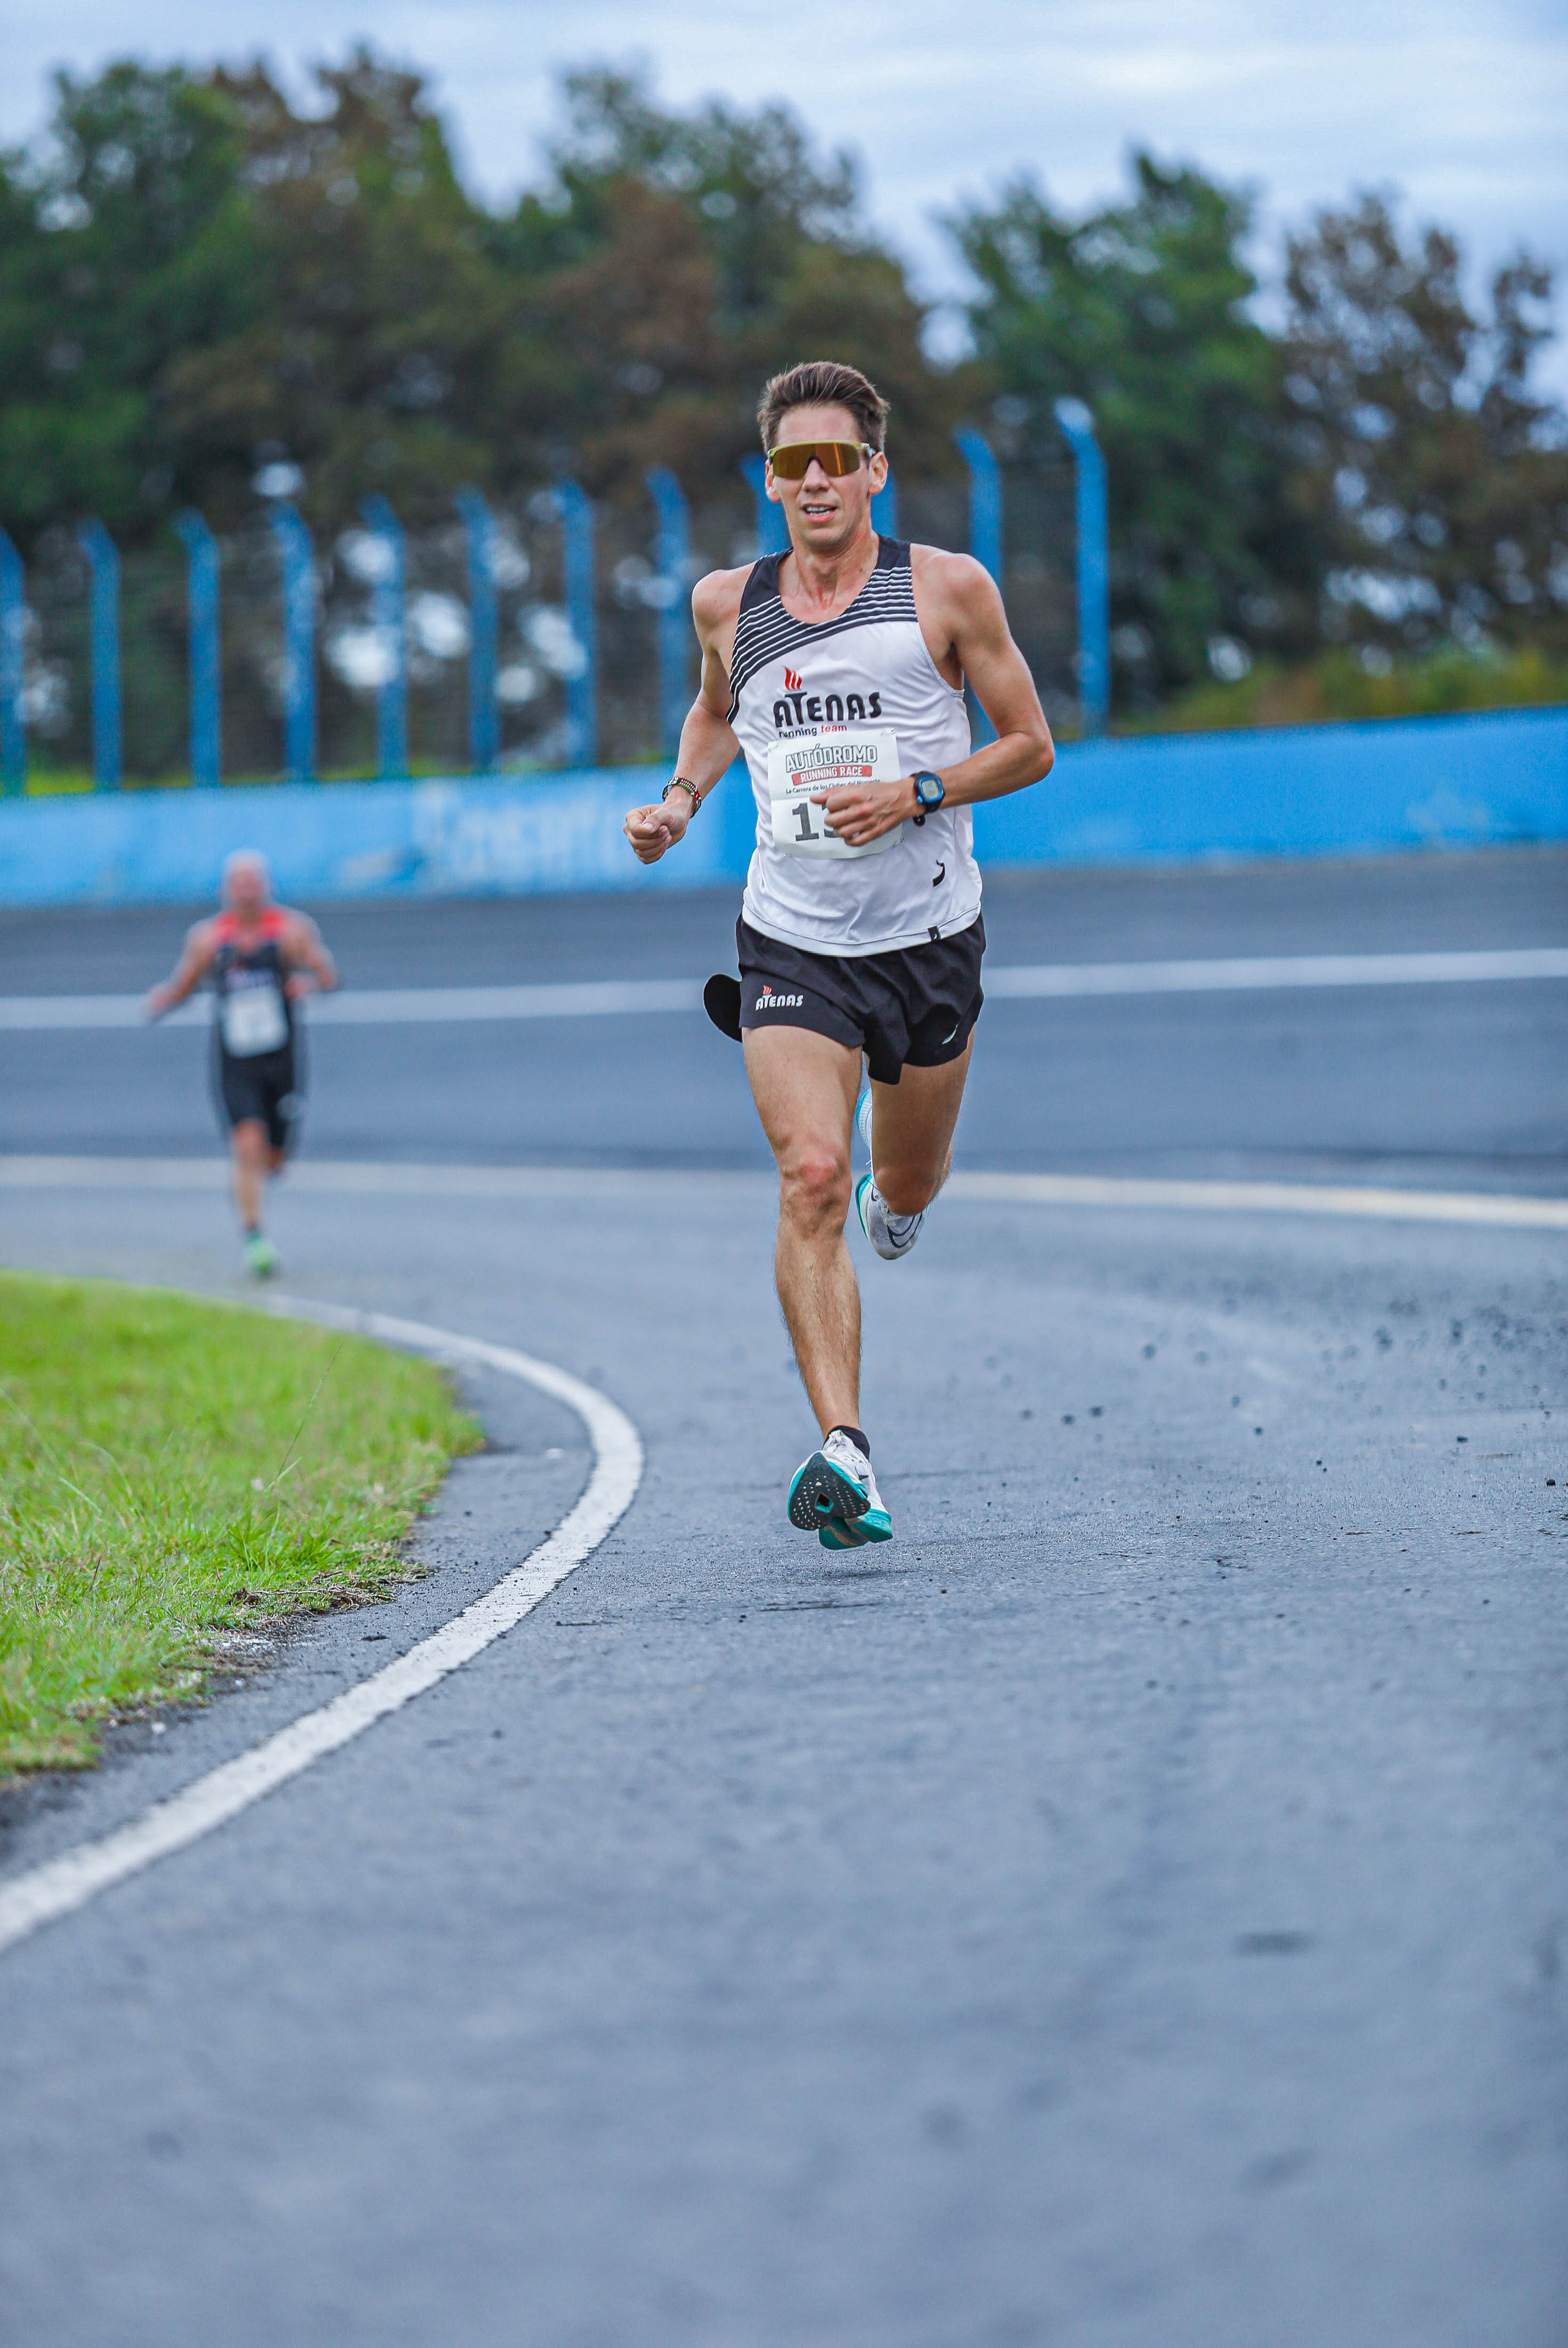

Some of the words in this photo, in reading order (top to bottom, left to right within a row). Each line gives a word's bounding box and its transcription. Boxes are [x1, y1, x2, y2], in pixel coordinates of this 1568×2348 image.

[779, 727, 817, 738] running
[786, 743, 878, 773] AUTÓDROMO
[800, 768, 837, 783] RUNNING
[840, 766, 863, 777] RACE
